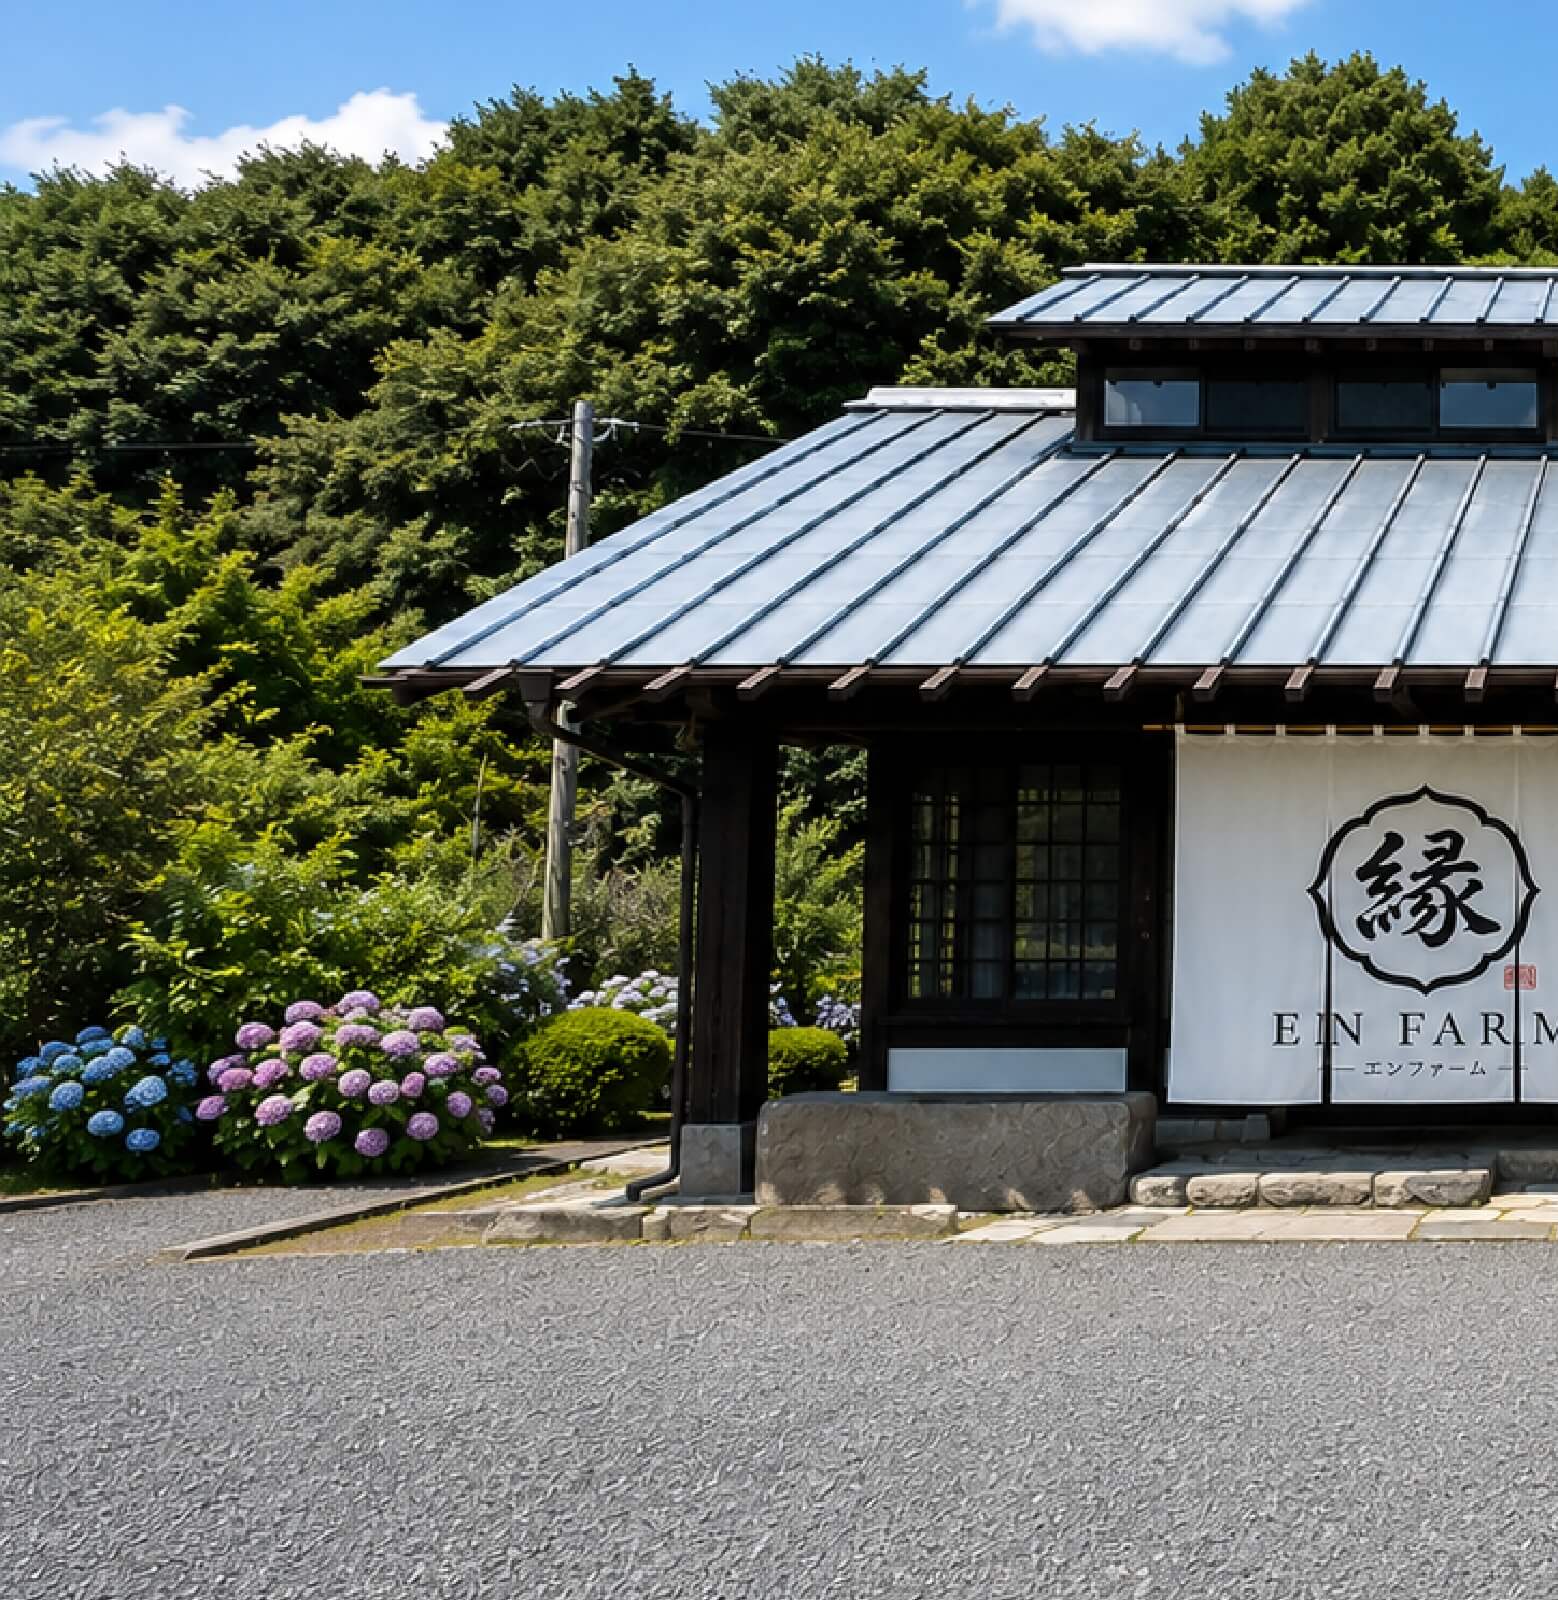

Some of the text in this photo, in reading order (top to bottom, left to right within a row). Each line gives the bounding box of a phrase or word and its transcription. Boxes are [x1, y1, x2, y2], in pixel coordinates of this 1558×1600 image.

[1356, 830, 1501, 947] 縁
[1363, 1061, 1486, 1077] エンファーム
